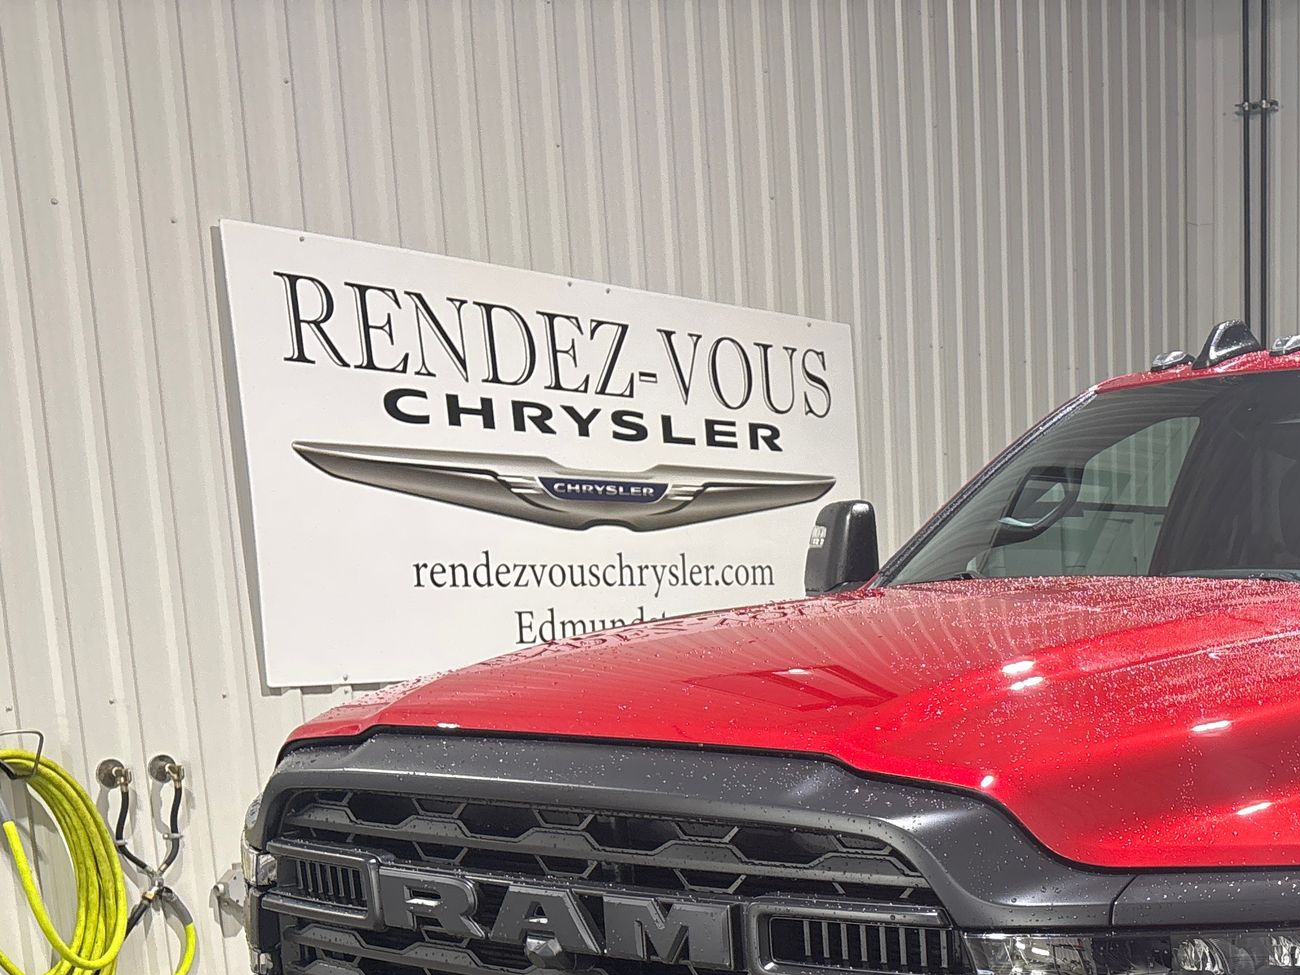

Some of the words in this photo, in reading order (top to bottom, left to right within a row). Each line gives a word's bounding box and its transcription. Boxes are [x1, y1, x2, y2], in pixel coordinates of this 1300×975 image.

[273, 271, 832, 419] RENDEZ-VOUS
[383, 388, 784, 452] CHRYSLER
[553, 482, 655, 497] CHRYSLER
[413, 550, 775, 598] rendezvouschrysler.com
[379, 866, 735, 970] RAM
